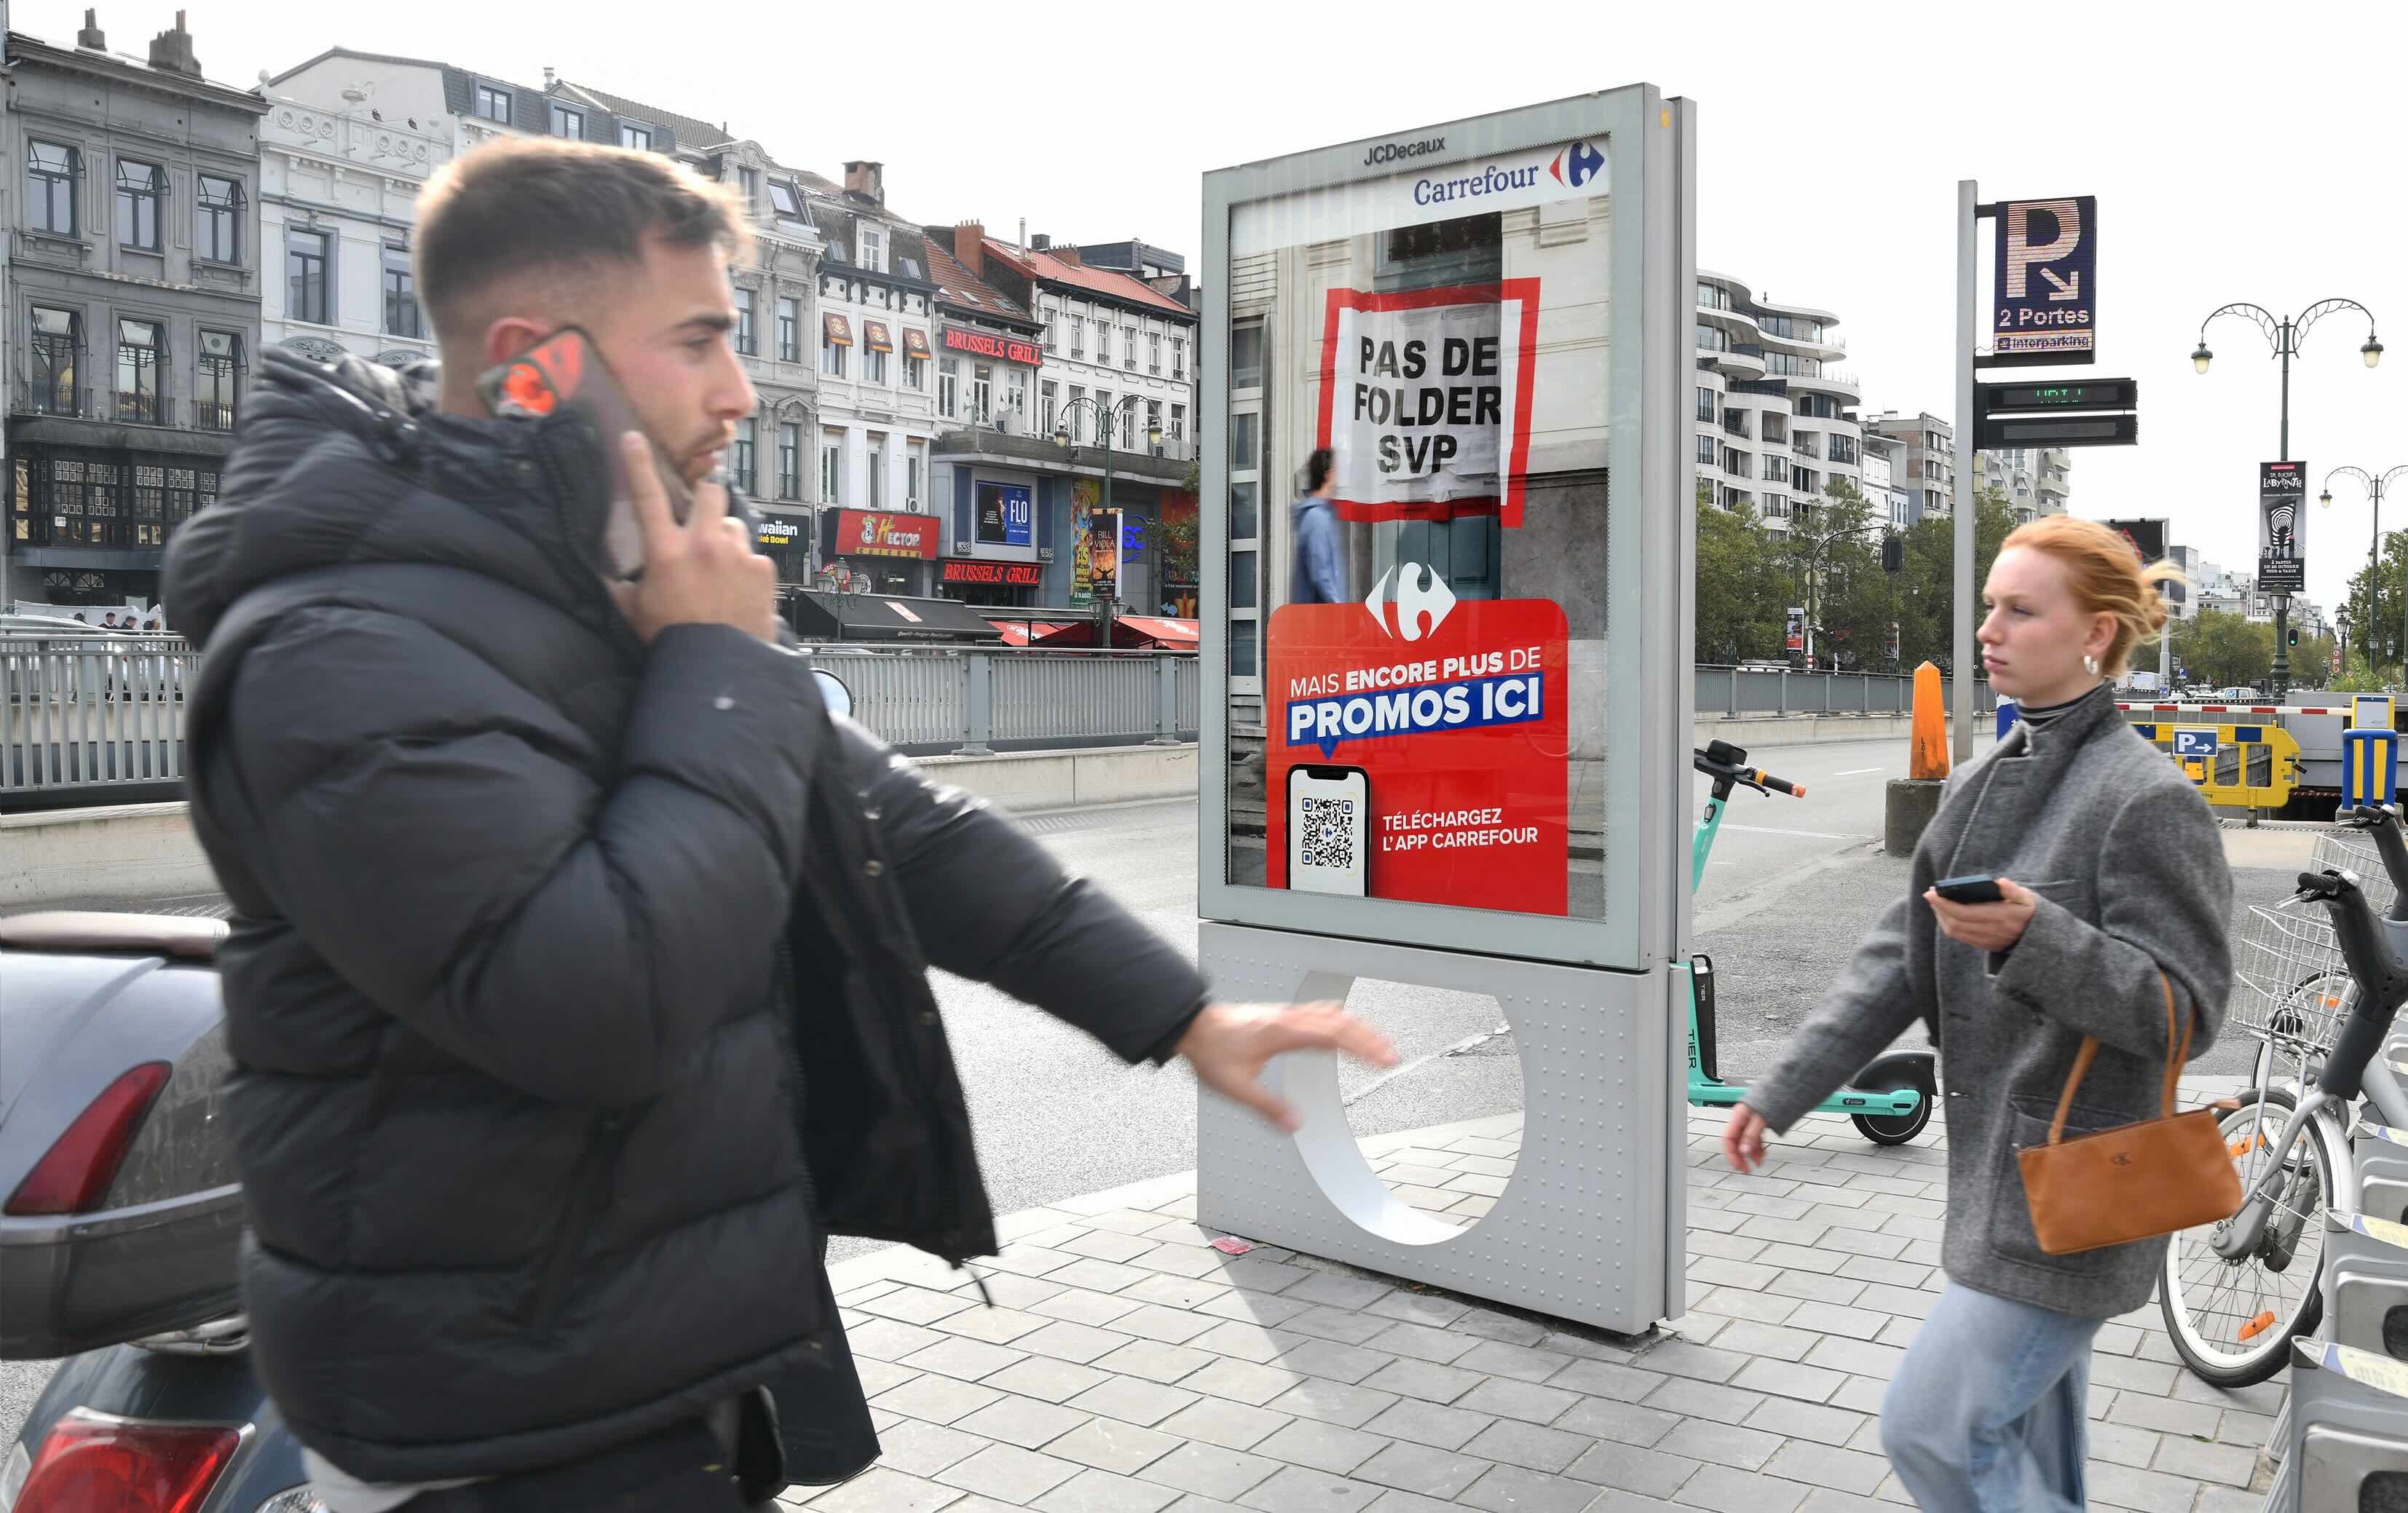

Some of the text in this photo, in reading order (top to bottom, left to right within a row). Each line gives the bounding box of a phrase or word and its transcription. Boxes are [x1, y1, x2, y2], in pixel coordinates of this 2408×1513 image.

[1364, 137, 1445, 166] JCDecaux
[1414, 165, 1539, 205] Carrefour
[2006, 200, 2080, 298] P
[1999, 307, 2090, 326] 2 Portes
[946, 331, 1005, 357] BRUSSELS
[1008, 344, 1042, 365] GRILL
[2013, 336, 2089, 350] Interparking
[1360, 335, 1499, 379] PAS DE
[1354, 382, 1501, 427] FOLDER
[1377, 435, 1457, 474] SVP
[2262, 478, 2302, 489] LABYRINTH
[1010, 500, 1027, 524] FLO
[758, 520, 798, 536] waiian
[1098, 530, 1112, 539] BILL
[1122, 525, 1145, 548] GC
[770, 536, 789, 545] Bowl
[957, 541, 971, 553] UGC
[1094, 540, 1116, 549] VIOLA
[1040, 548, 1053, 558] UGC
[944, 564, 1040, 584] BRUSSELS GRILL
[1290, 647, 1541, 698] MAIS ENCORE PLUS DE
[1290, 676, 1539, 740] PROMOS ICI
[2178, 733, 2196, 753] P
[1383, 808, 1502, 831] TÉLÉCHARGEZ
[1383, 827, 1538, 851] L'APP CARREFOUR
[1688, 1028, 1697, 1070] TIER
